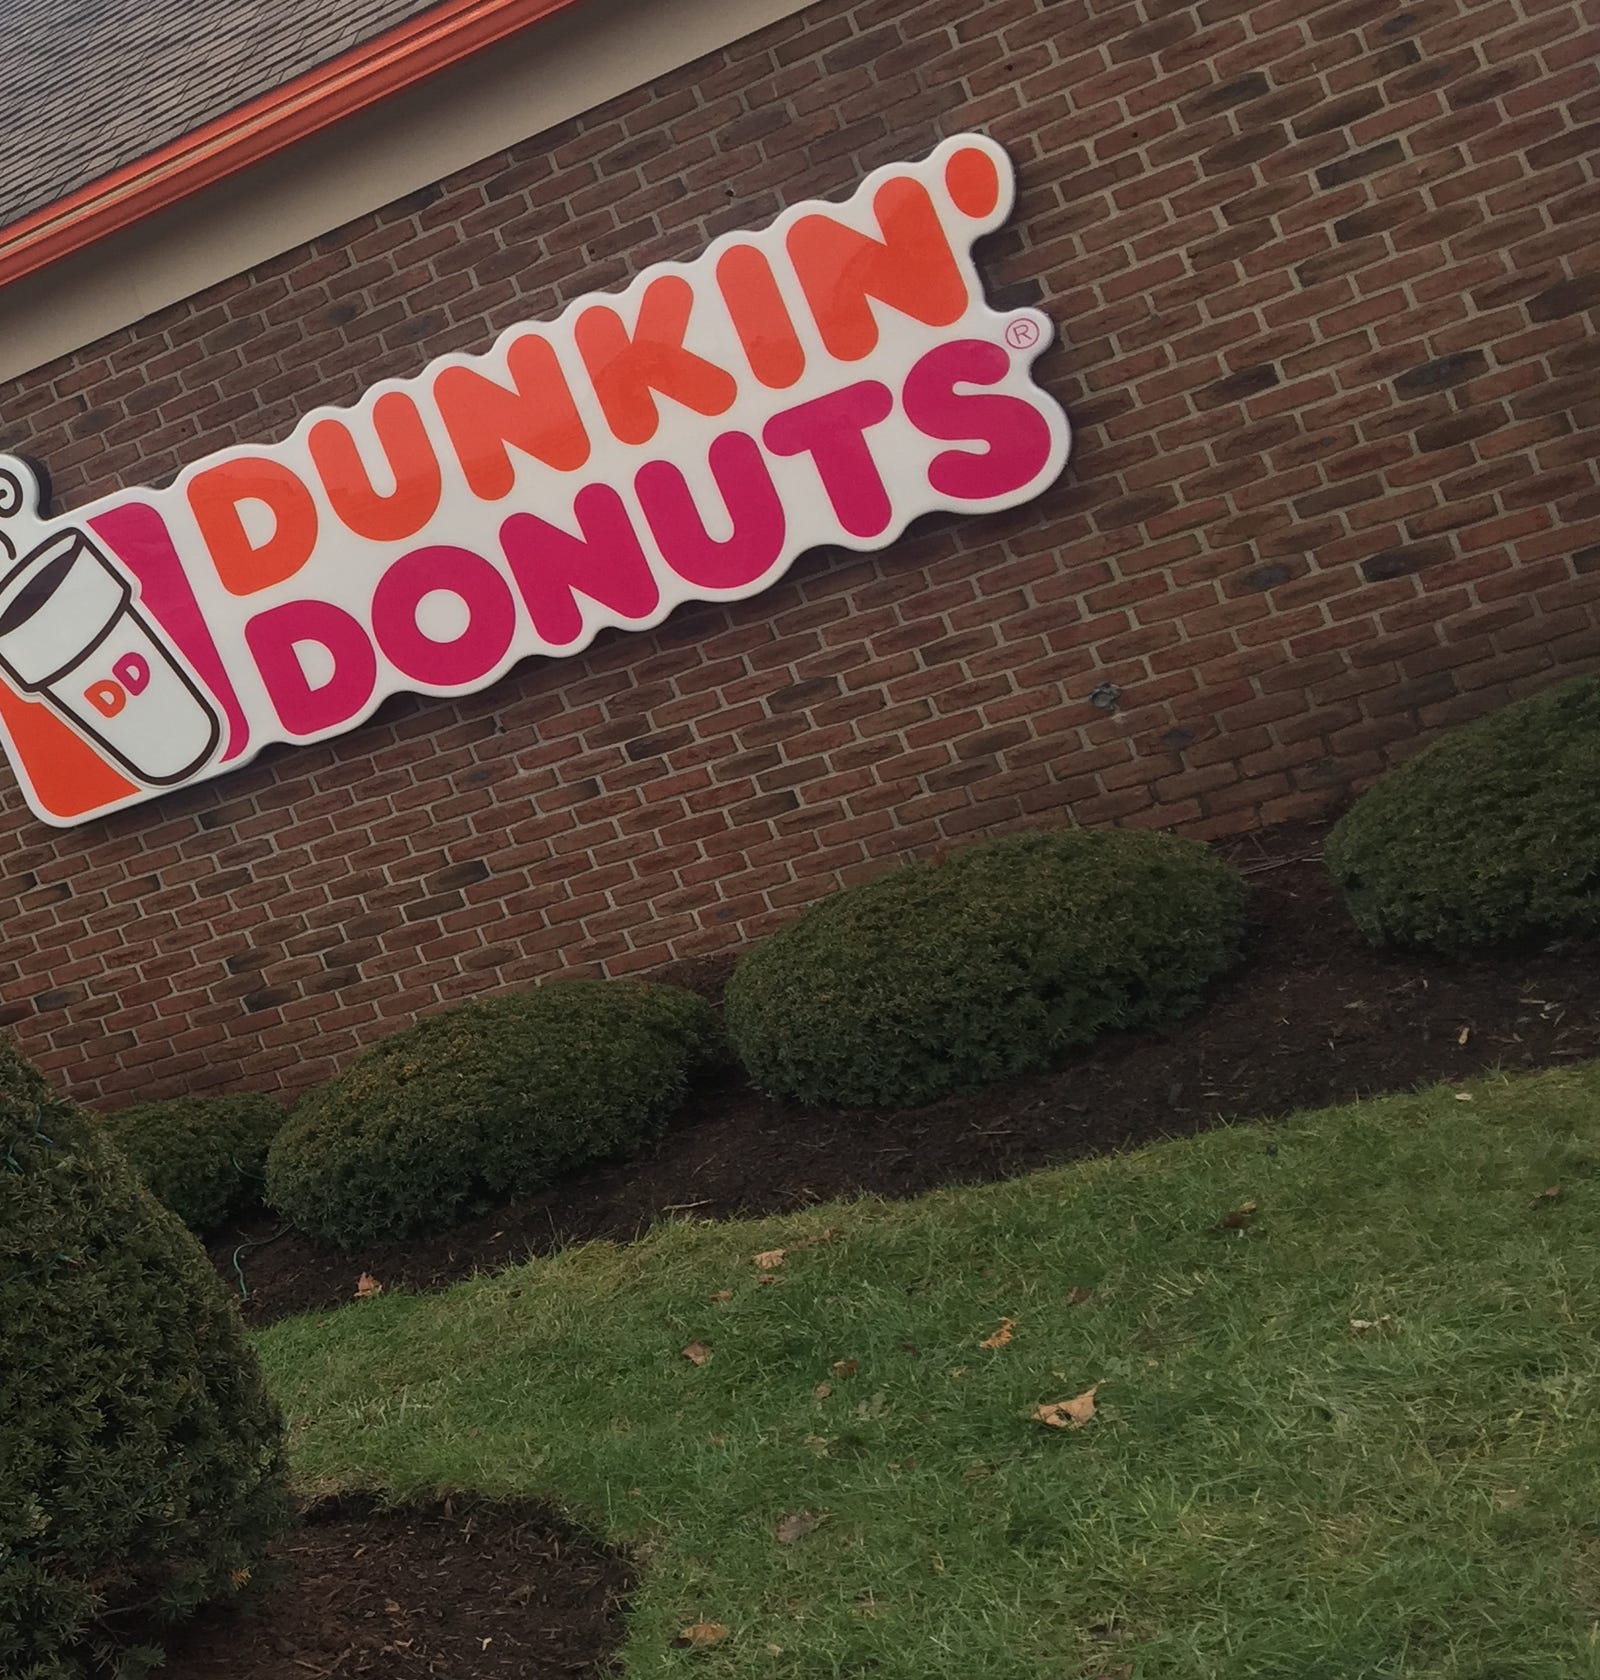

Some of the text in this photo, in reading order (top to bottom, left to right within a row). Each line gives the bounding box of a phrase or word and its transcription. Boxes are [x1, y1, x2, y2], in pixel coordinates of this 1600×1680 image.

[186, 148, 1000, 596] DUNKIN'
[244, 339, 1052, 736] DONUTS
[83, 652, 150, 718] DD
